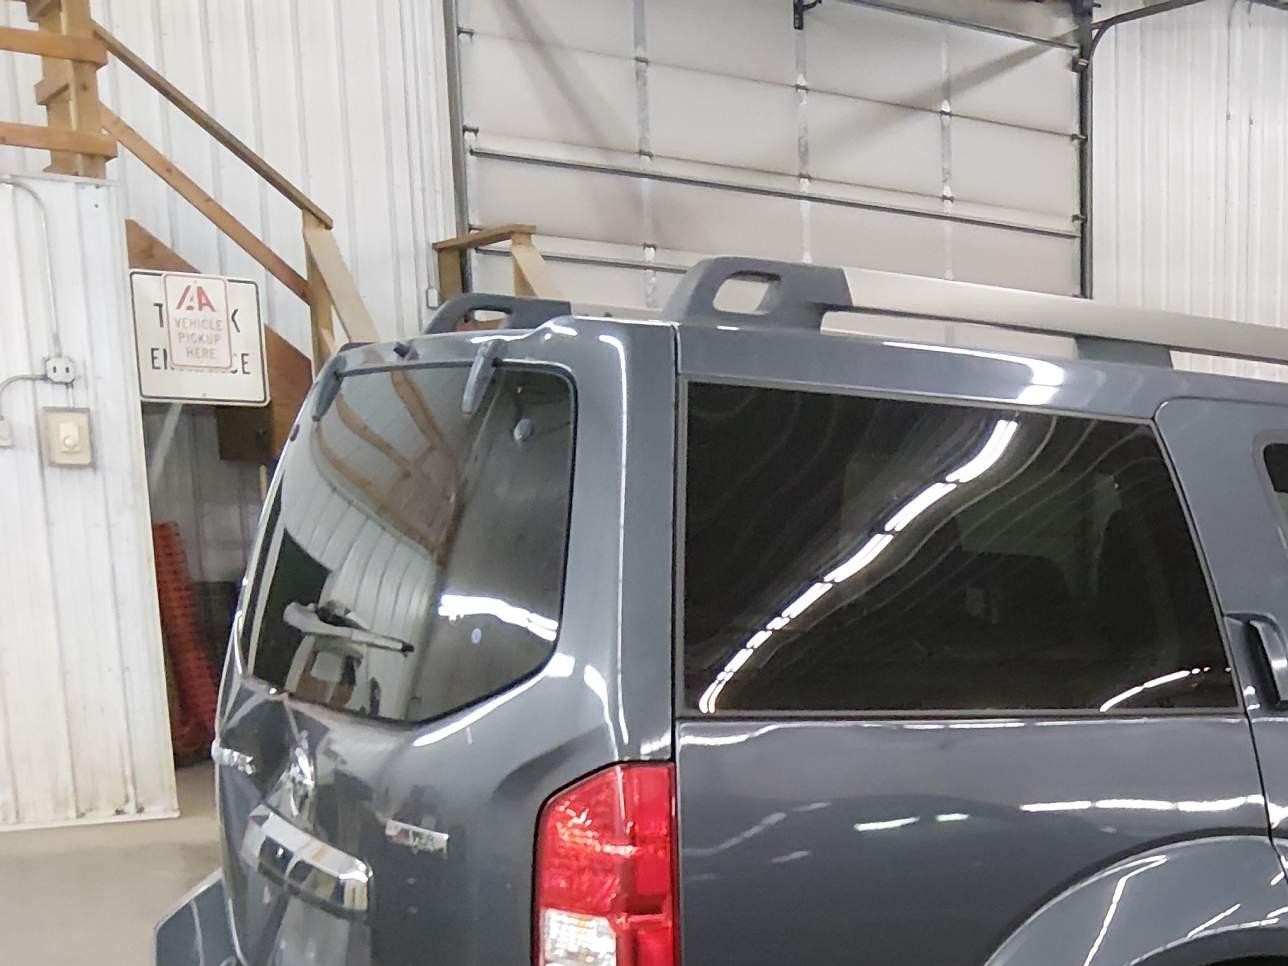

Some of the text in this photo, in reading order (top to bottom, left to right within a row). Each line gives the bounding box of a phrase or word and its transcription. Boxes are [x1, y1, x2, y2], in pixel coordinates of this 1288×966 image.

[174, 318, 224, 332] VEHICLE
[177, 332, 223, 346] PICKUP
[185, 347, 217, 360] HERE
